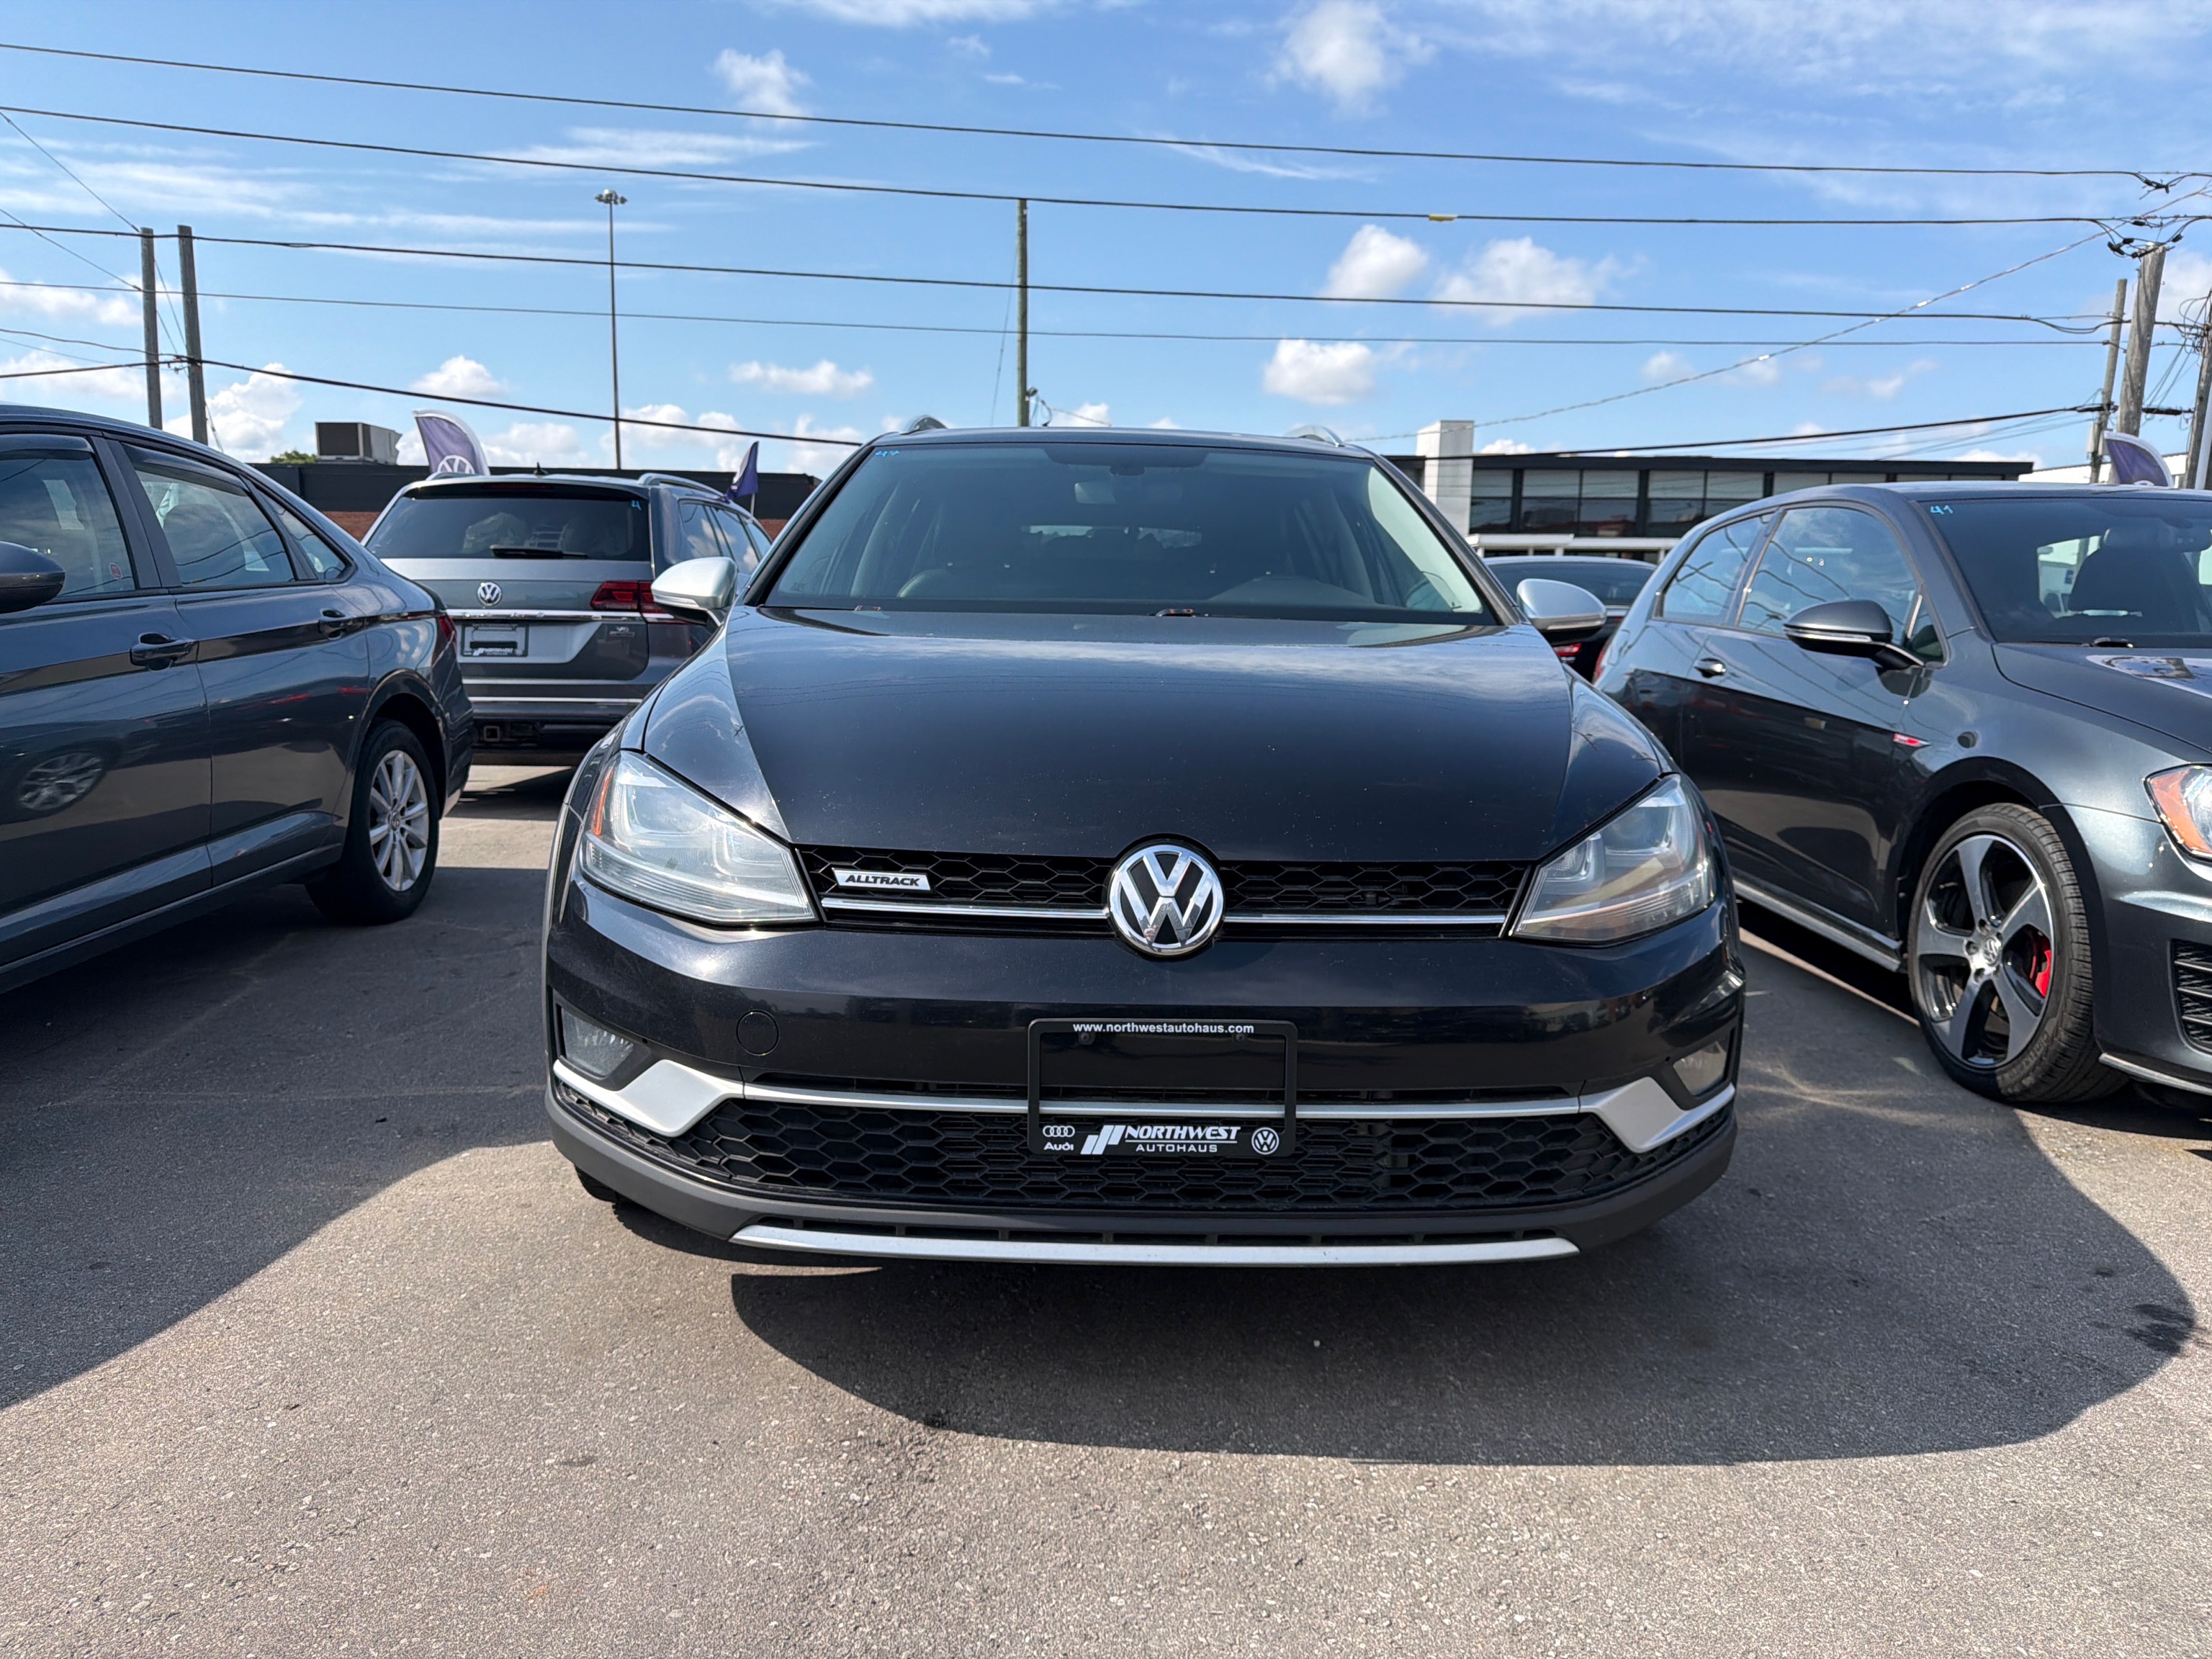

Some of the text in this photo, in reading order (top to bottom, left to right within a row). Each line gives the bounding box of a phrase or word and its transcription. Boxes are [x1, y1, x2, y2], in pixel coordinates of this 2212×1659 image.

[845, 874, 920, 886] ALLTRACK
[1109, 844, 1223, 956] VW
[1072, 1022, 1255, 1033] www.northwestautohaus.com
[1124, 1125, 1241, 1140] NORTHWEST
[1043, 1141, 1074, 1151] Audi
[1136, 1143, 1218, 1153] AUTOHAUS
